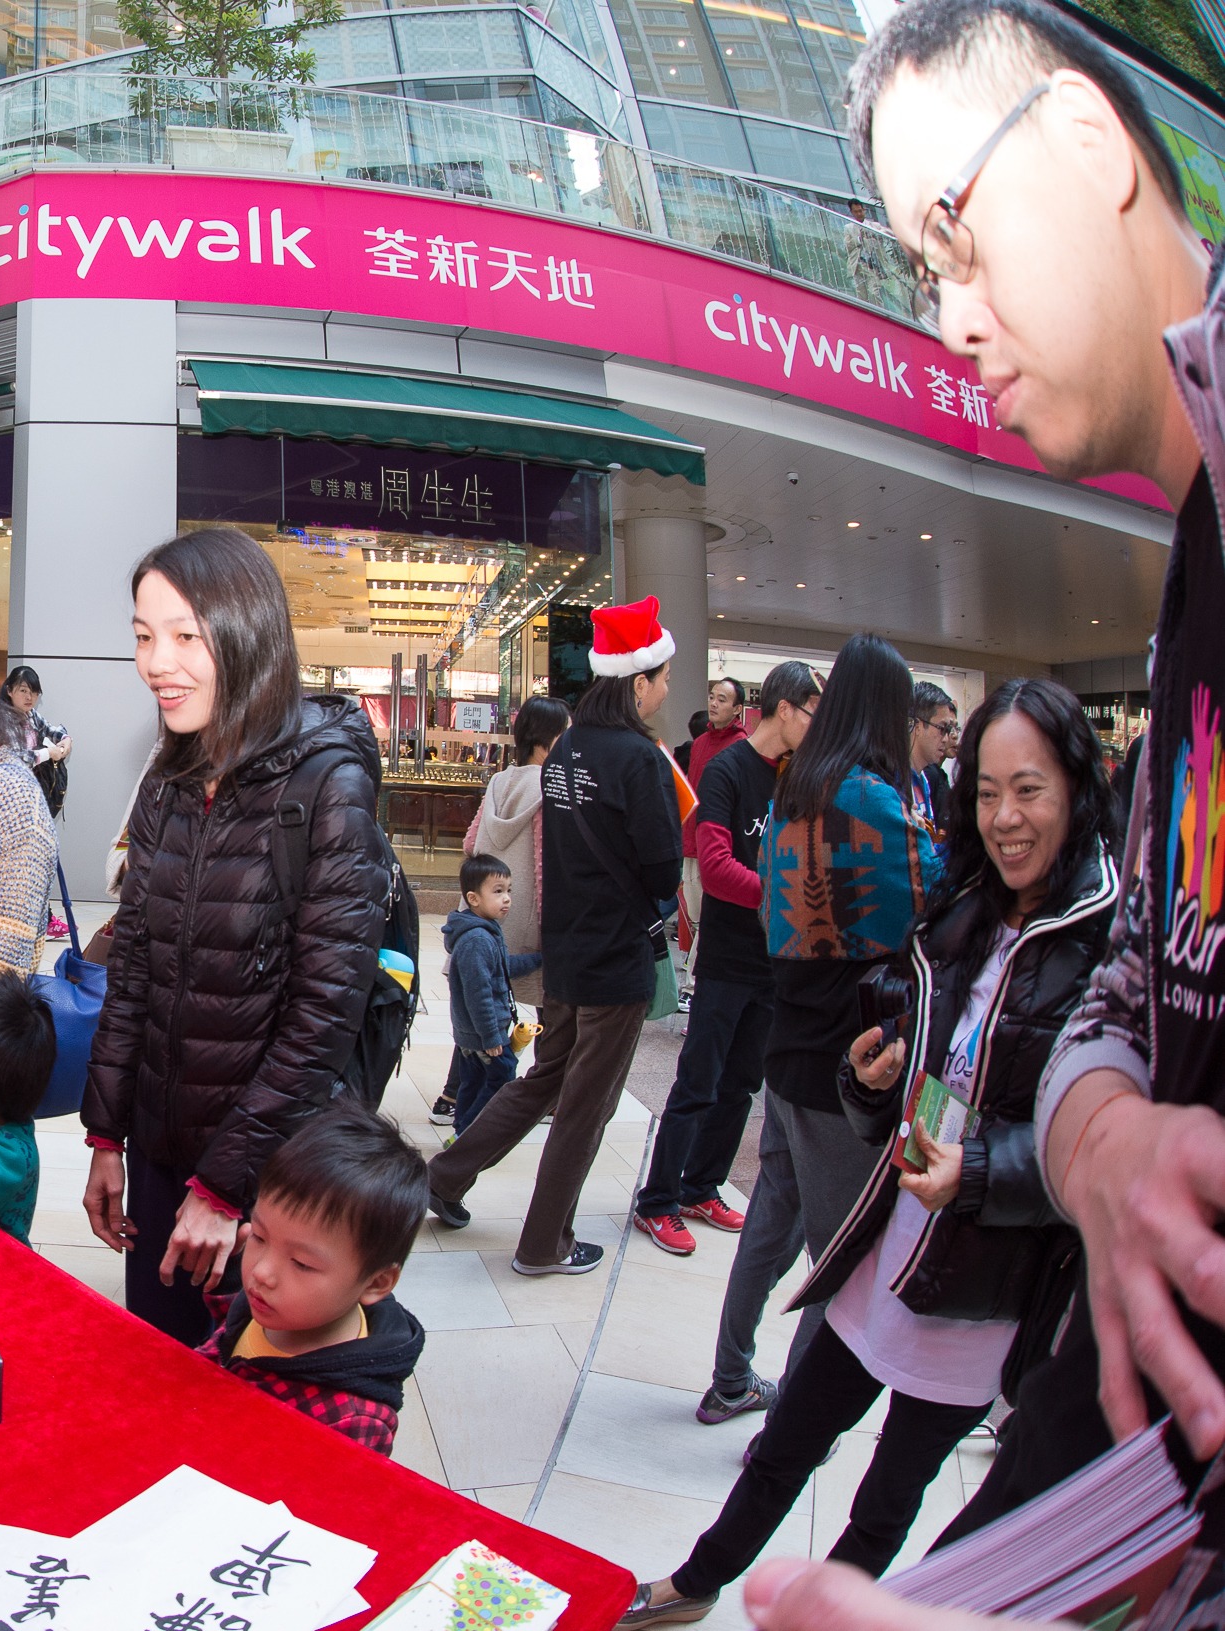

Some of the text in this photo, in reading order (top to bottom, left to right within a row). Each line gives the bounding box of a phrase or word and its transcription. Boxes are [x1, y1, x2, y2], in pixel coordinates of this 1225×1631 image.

[363, 226, 596, 310] 荃新天地
[704, 293, 914, 399] citywalk
[377, 465, 496, 526] 周生生
